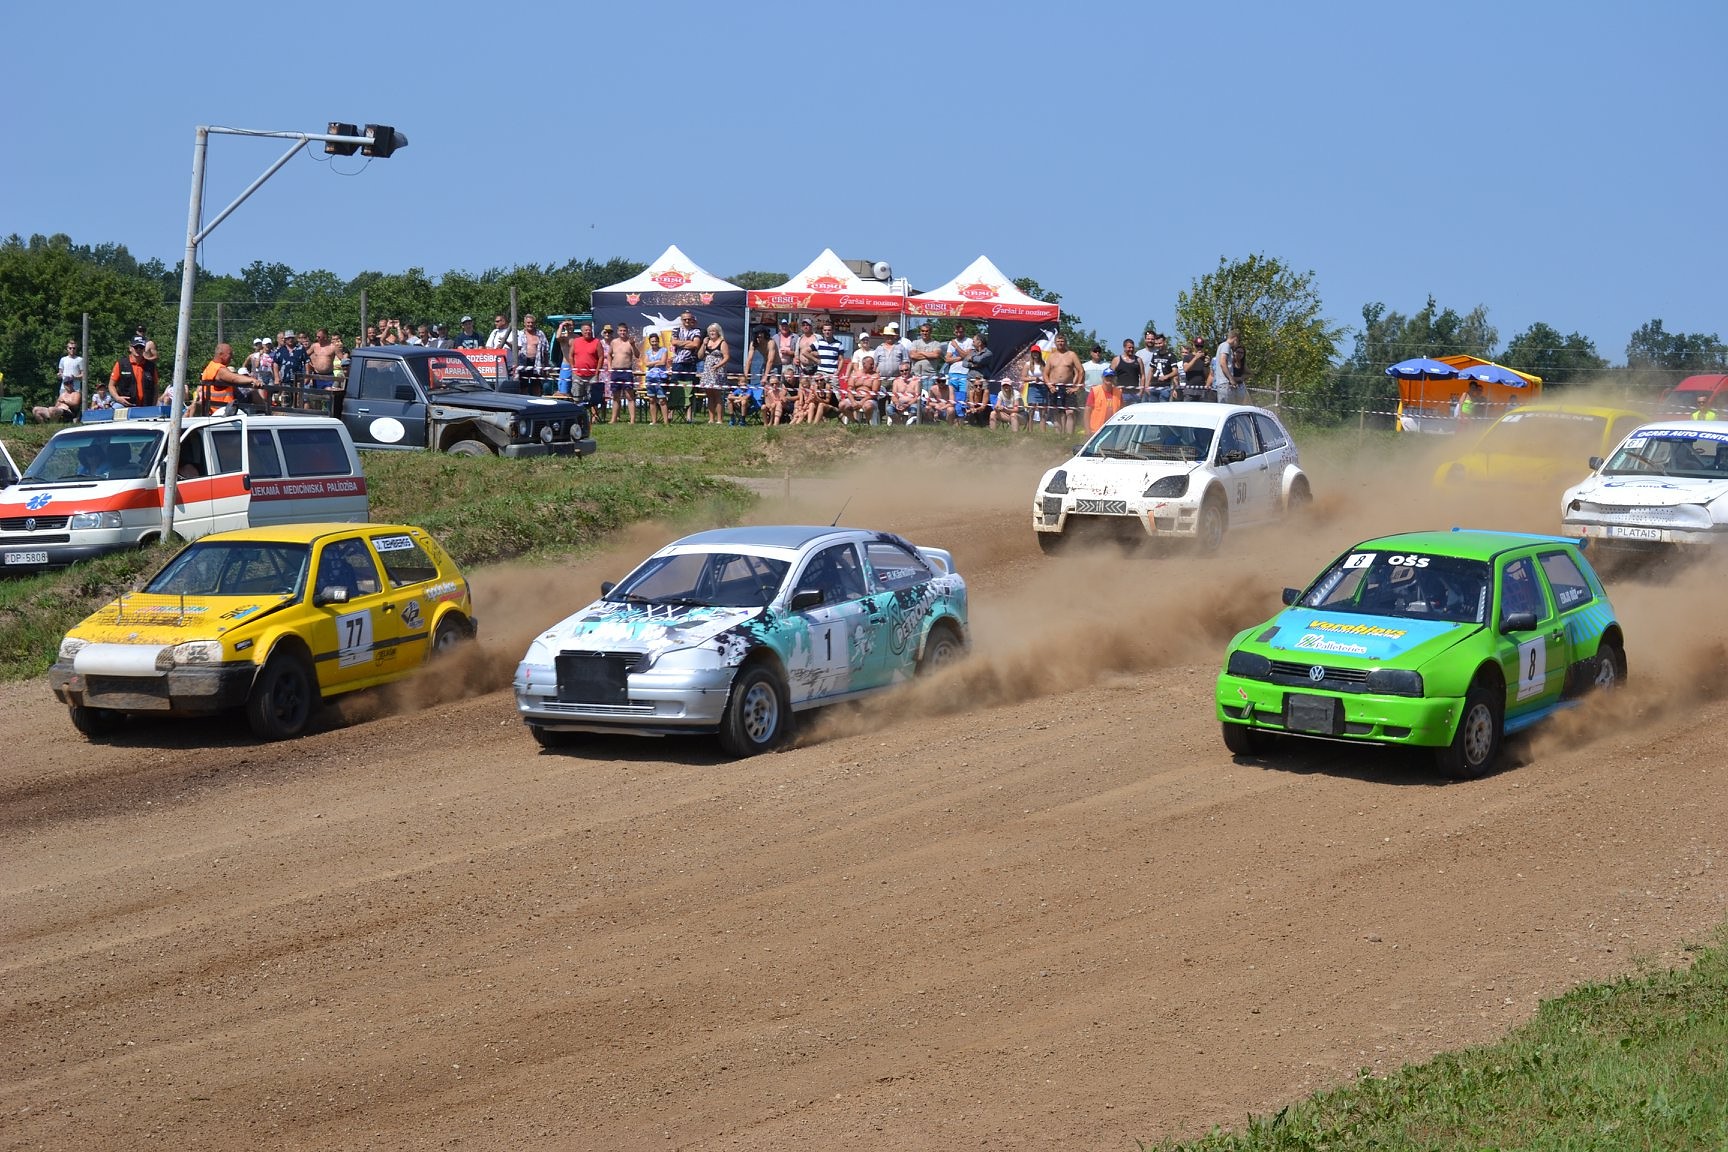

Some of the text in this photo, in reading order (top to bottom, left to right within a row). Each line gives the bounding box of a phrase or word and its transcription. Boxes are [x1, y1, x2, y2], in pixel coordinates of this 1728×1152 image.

[283, 482, 324, 495] MEDICĪNISKĀ
[327, 481, 358, 492] PALĪDZĪBA
[1237, 482, 1247, 504] 50
[1617, 528, 1657, 538] PLATAIS
[1354, 555, 1366, 567] 8
[1388, 554, 1431, 568] OŠS
[347, 617, 363, 648] 77
[824, 628, 831, 660] 1
[1528, 648, 1536, 680] 8
